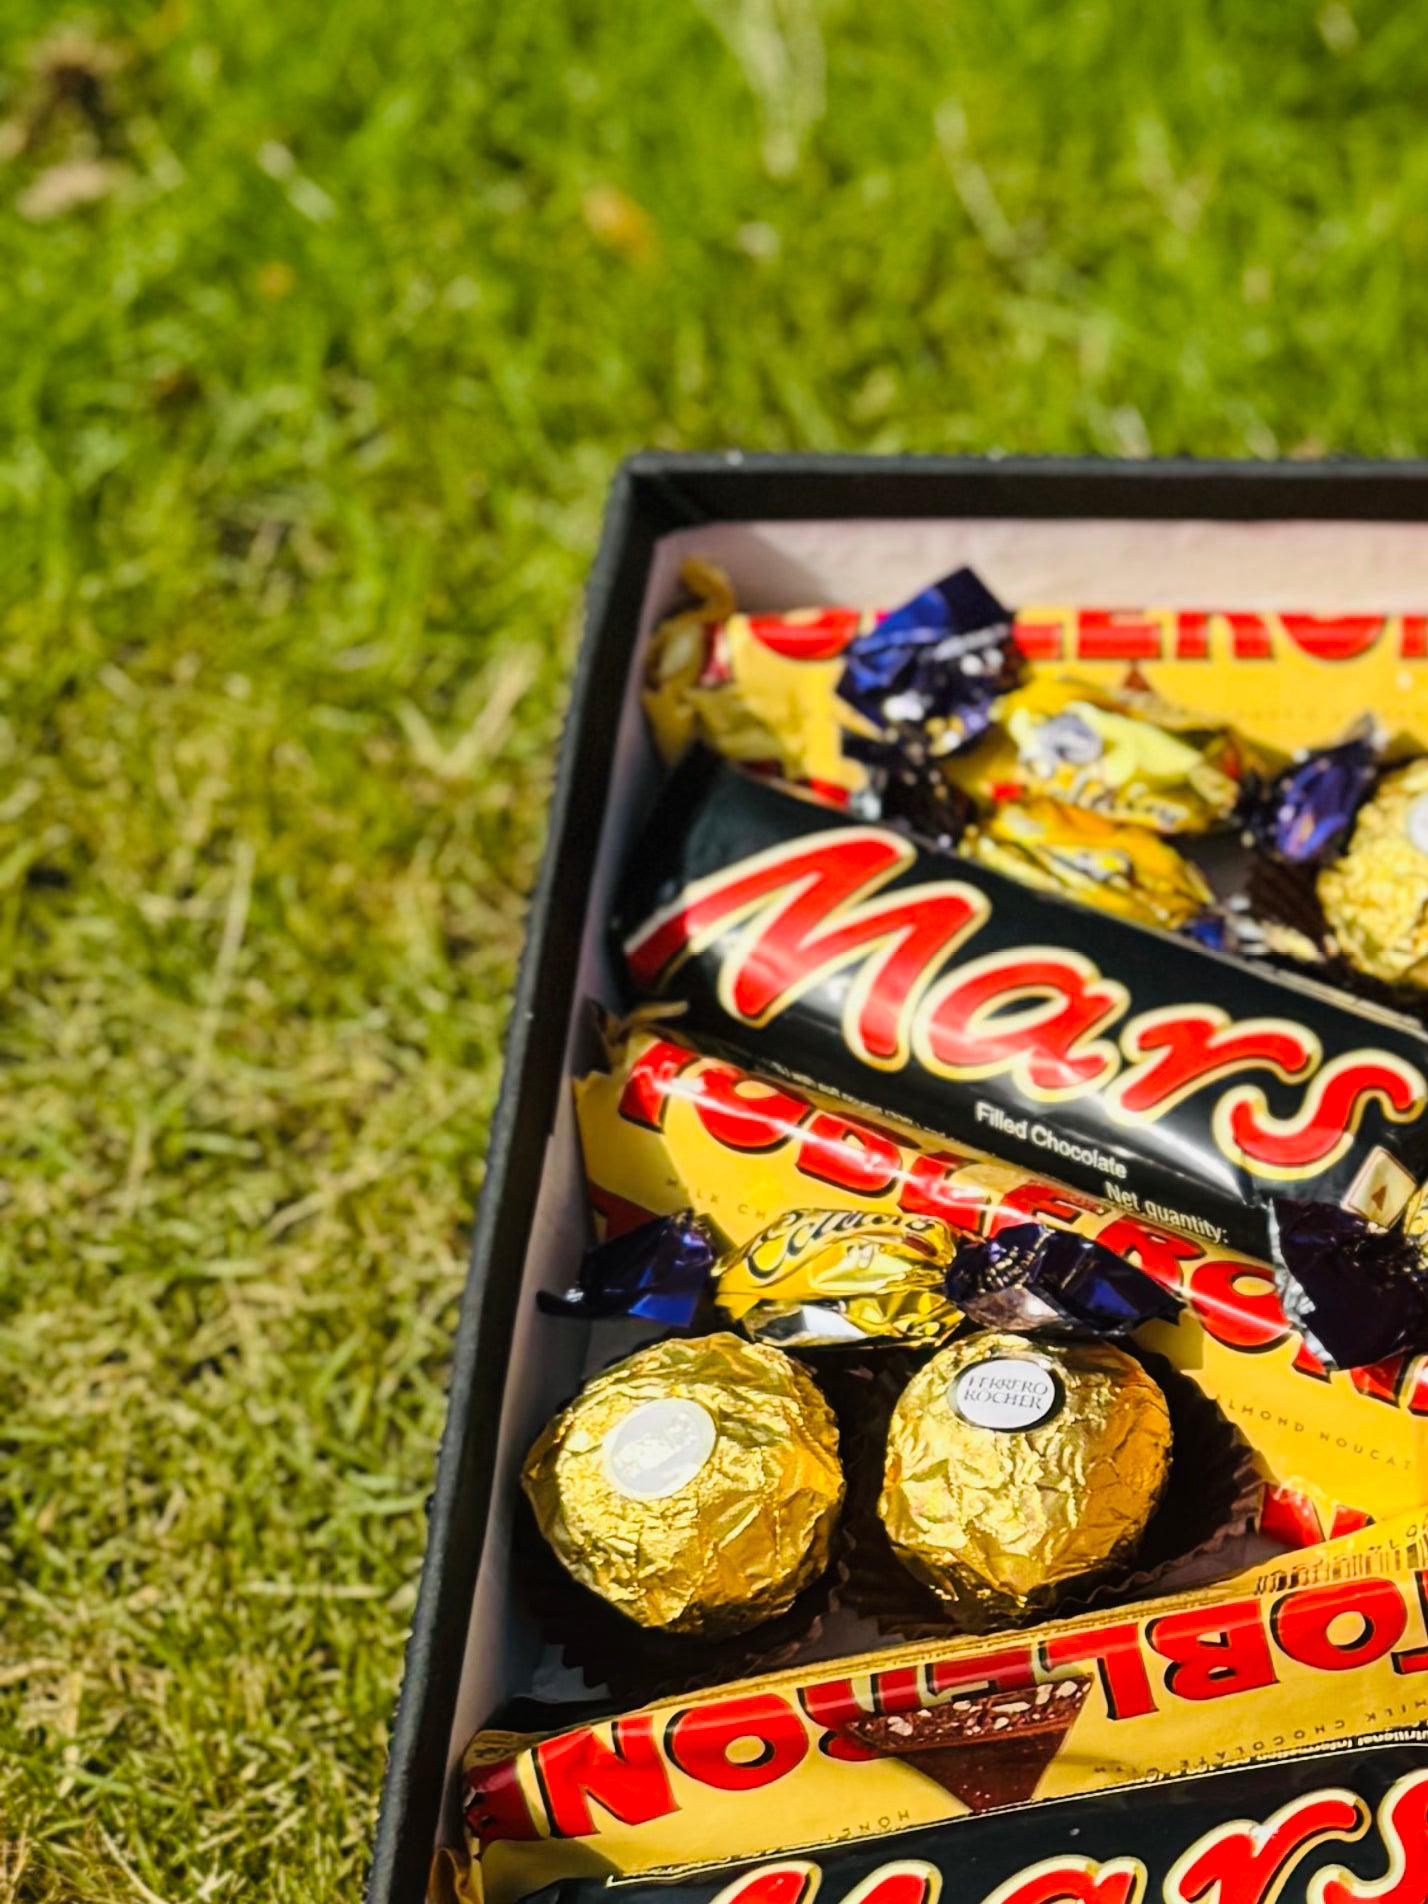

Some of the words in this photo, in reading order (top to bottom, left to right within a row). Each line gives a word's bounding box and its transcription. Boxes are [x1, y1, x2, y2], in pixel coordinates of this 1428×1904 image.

[622, 825, 1428, 1180] Mars
[974, 1100, 1028, 1141] Filled
[1030, 1123, 1128, 1180] Chocolate
[963, 1389, 1045, 1411] ROCHER
[969, 1375, 1049, 1397] FERRERO
